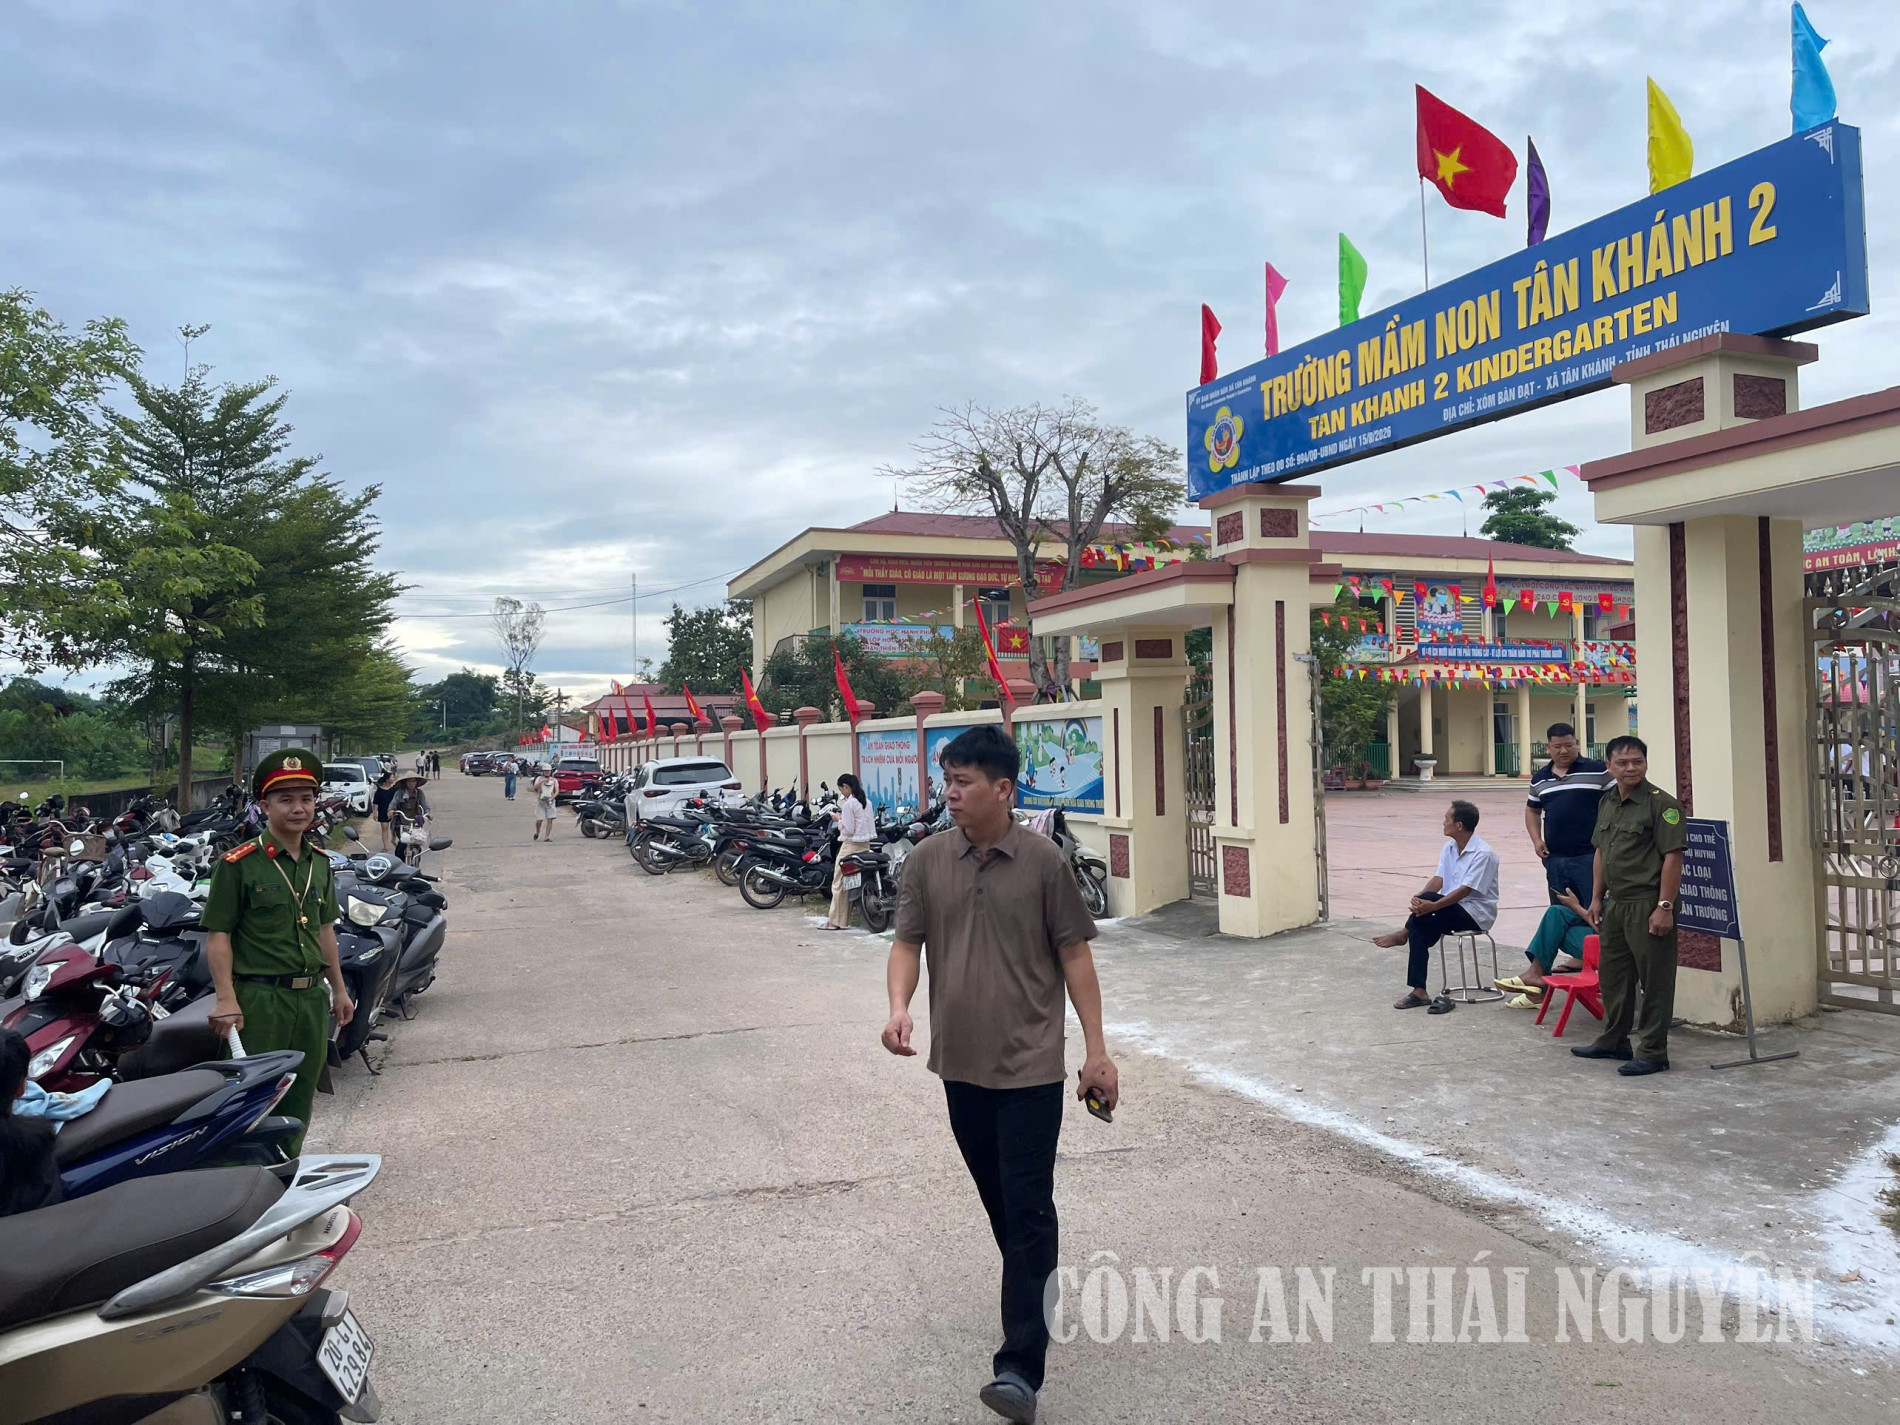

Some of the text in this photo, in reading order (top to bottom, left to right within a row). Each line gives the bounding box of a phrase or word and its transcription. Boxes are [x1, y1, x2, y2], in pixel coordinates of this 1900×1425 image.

[1260, 181, 1777, 421] TRƯỜNG MẦM NON TÂN KHÁNH 2
[1308, 291, 1678, 440] TAN KHANH 2 KINDERGARTEN
[1443, 405, 1457, 422] ĐỊA
[1458, 396, 1475, 417] CHỈ:
[1476, 393, 1496, 411] XÓM
[1497, 387, 1515, 405] BÀN
[1517, 381, 1535, 399] ĐẠT
[1546, 371, 1559, 390] XÃ
[1560, 366, 1580, 386] TÂN
[1581, 355, 1616, 380] KHÁNH
[1626, 344, 1651, 362] TỈNH
[1655, 333, 1680, 352] THÁI
[1683, 319, 1730, 344] NGUYÊN
[1261, 462, 1275, 476] THEO
[1338, 436, 1356, 453] NGÀY
[1815, 557, 1830, 568] AN
[1690, 833, 1703, 843] CHO
[1703, 833, 1716, 844] TRẺ
[1682, 848, 1694, 858] HỤ
[1692, 864, 1712, 881] LOẠI
[1699, 885, 1728, 901] THÔNG
[1694, 904, 1728, 921] TRƯỜNG
[135, 1125, 209, 1165] VISION
[323, 1211, 339, 1234] HONDA
